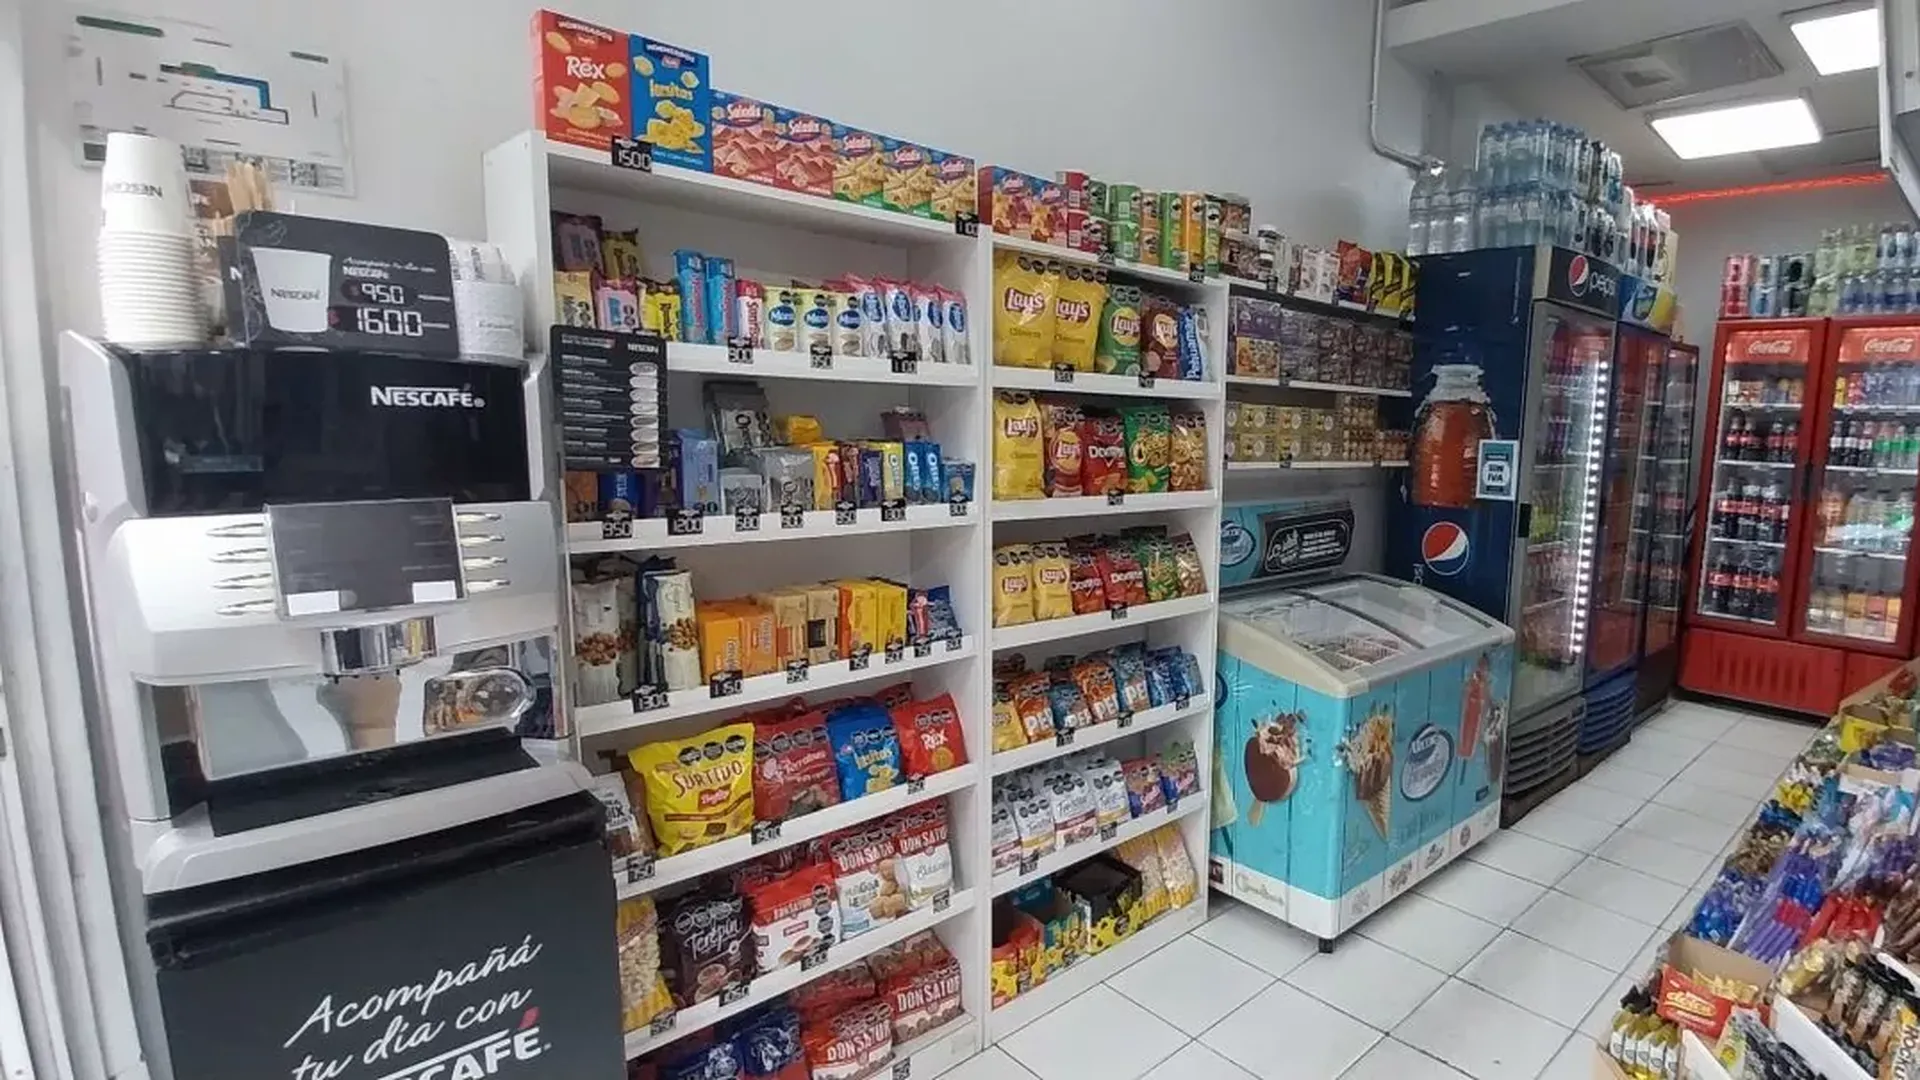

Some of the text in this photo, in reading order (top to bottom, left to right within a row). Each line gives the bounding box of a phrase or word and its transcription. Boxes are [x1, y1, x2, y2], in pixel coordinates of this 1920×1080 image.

[361, 284, 404, 304] 950
[357, 308, 423, 337] 1600
[370, 382, 485, 408] NESCAFÉ
[603, 522, 631, 537] 950
[672, 759, 744, 798] SURTIDO
[283, 934, 543, 1048] Acompañá
[896, 990, 925, 1013] DON
[363, 1015, 445, 1065] día
[455, 989, 533, 1029] con
[826, 1040, 857, 1062] DON
